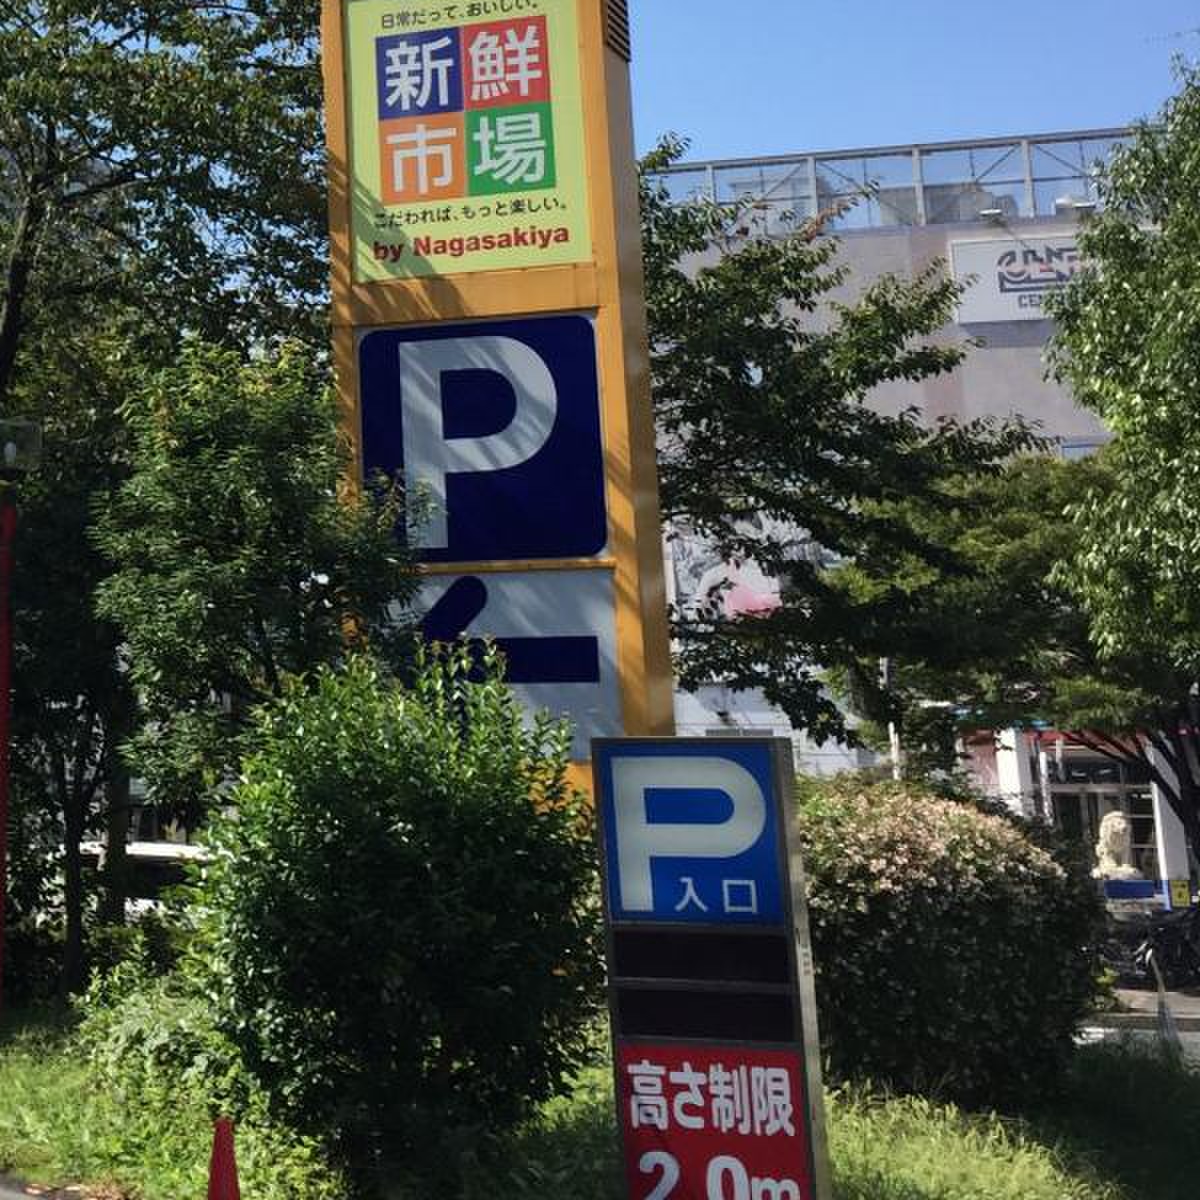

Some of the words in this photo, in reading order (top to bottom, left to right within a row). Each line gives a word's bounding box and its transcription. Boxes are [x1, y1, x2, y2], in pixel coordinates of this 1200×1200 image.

[384, 25, 543, 112] 新鮮
[386, 112, 547, 195] 市場
[373, 241, 405, 263] by
[413, 225, 570, 257] Nagasakiya
[399, 335, 557, 548] P
[610, 756, 767, 912] P
[675, 876, 759, 914] 入口
[627, 1059, 796, 1137] 高さ制限
